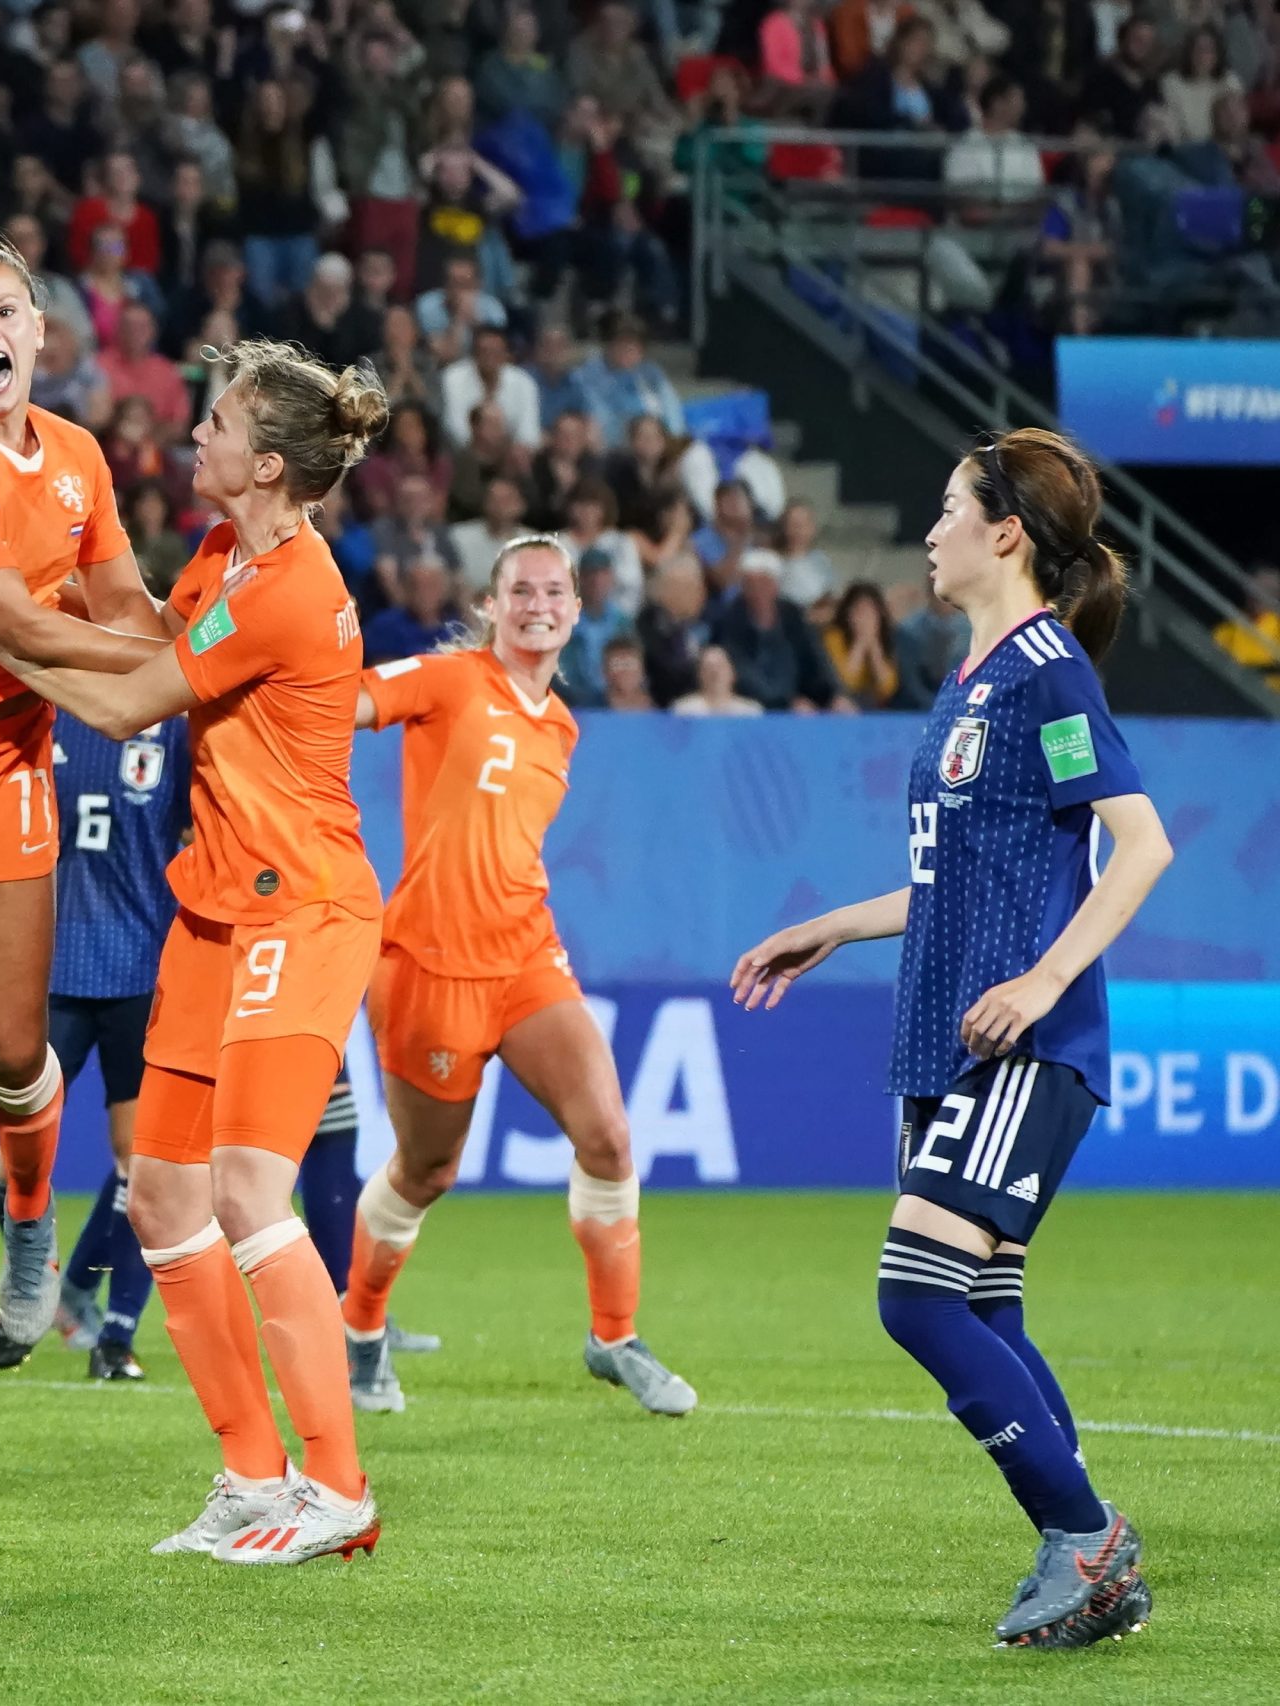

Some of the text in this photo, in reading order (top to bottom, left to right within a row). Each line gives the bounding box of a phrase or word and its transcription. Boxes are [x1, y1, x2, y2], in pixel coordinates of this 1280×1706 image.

[477, 733, 516, 795] 2
[7, 768, 53, 836] 11
[75, 793, 111, 851] 6
[240, 938, 287, 1002] 9
[909, 1094, 976, 1174] 2
[977, 1421, 1026, 1451] PAN
